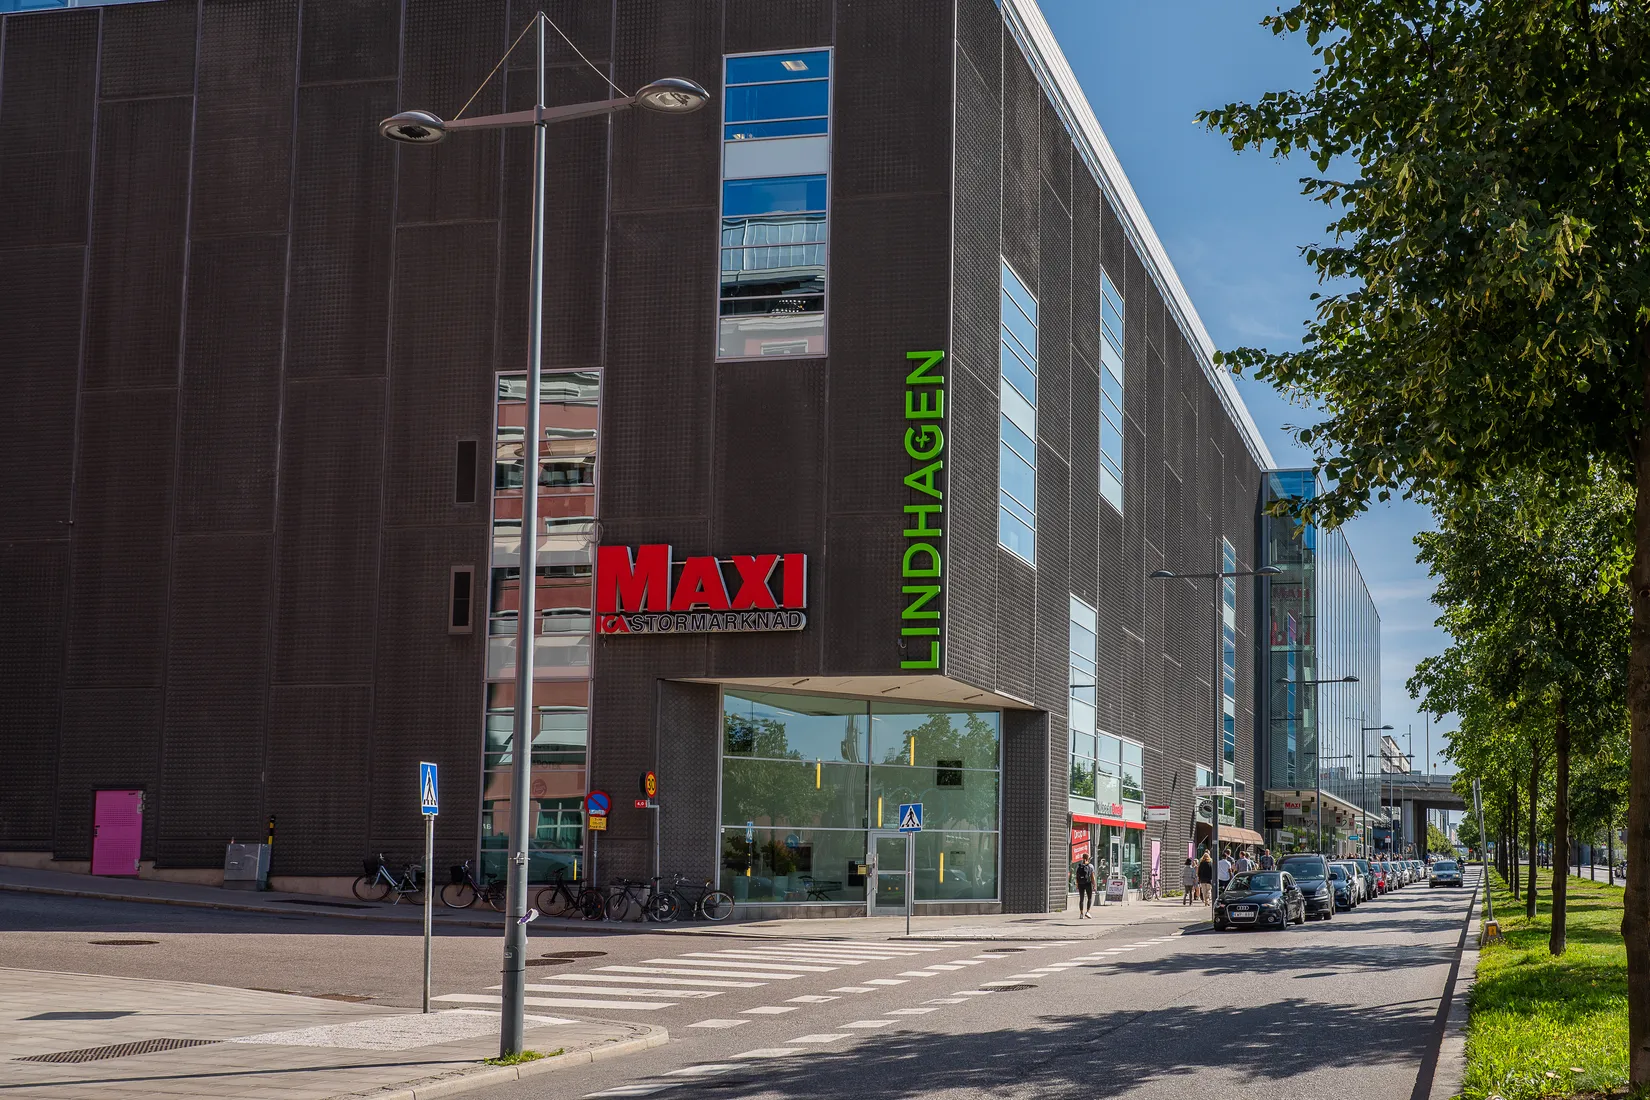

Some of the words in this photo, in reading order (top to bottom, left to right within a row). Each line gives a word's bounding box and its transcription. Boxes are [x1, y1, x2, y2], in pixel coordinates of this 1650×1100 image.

[900, 350, 945, 669] LINDHAGEN
[596, 544, 808, 613] MAXI
[596, 615, 630, 633] ICA
[631, 611, 807, 632] STORMARKNAD
[647, 778, 655, 791] 30
